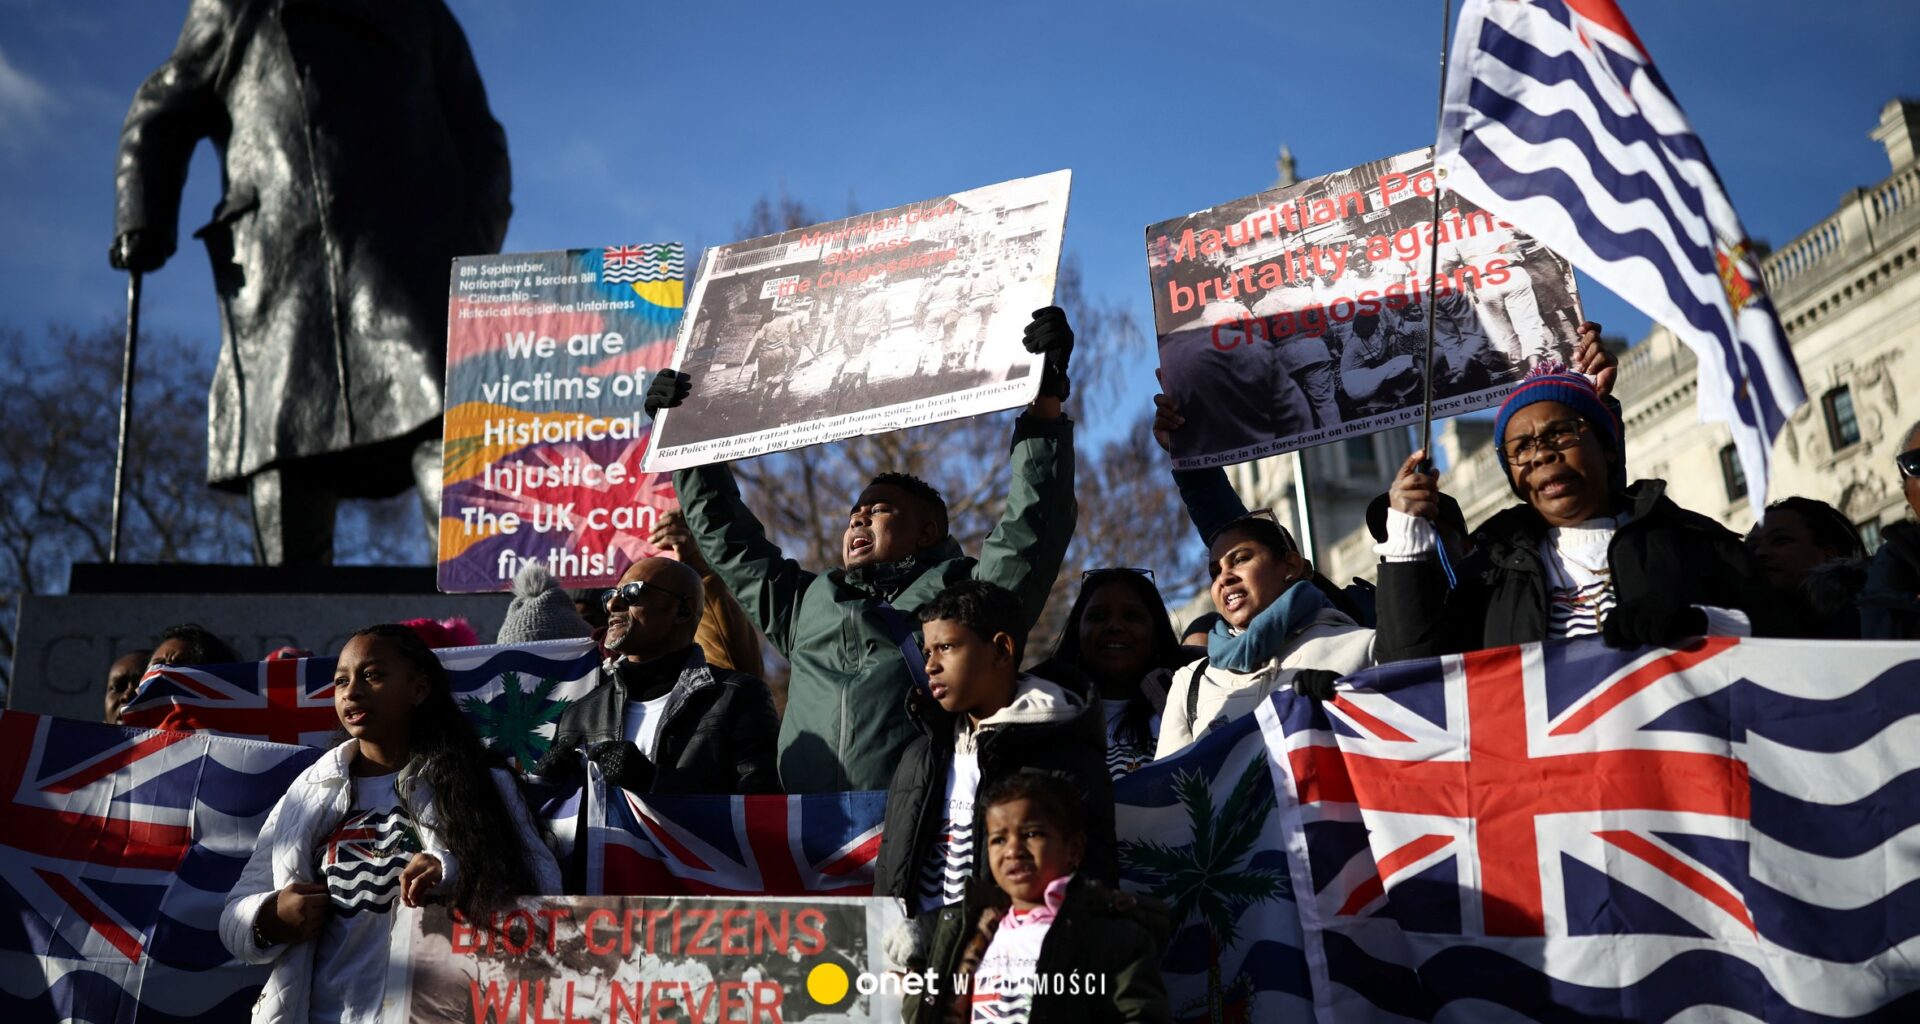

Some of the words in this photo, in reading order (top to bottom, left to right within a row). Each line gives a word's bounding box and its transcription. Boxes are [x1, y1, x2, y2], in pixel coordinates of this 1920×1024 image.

[800, 215, 899, 249] Mauritian
[460, 265, 477, 277] 8th
[777, 277, 811, 298] the
[816, 247, 957, 289] Chagossians
[1168, 244, 1348, 314] brutality
[1366, 207, 1513, 262] again
[460, 277, 520, 291] Nationality
[524, 277, 531, 287] &
[536, 275, 577, 286] Borders
[581, 271, 597, 283] Bill
[468, 290, 529, 304] Citizenship
[459, 306, 511, 319] Historical
[513, 302, 574, 318] Legislative
[576, 299, 635, 313] Unfairness
[1211, 258, 1511, 354] Chagossians
[505, 331, 557, 359] We
[567, 331, 624, 357] are
[482, 373, 601, 404] victims
[612, 367, 646, 397] of
[484, 411, 640, 446] Historical
[658, 448, 678, 459] Riot
[681, 444, 708, 456] Police
[711, 438, 732, 449] with
[734, 434, 757, 445] their
[759, 428, 789, 441] rattan
[792, 419, 826, 434] shields
[828, 416, 846, 428] and
[849, 411, 882, 424] batons
[884, 405, 912, 418] going
[915, 402, 925, 410] to
[928, 394, 956, 407] break
[960, 392, 973, 402] up
[976, 381, 1026, 398] protesters
[713, 449, 746, 461] during
[748, 445, 763, 455] the
[766, 440, 788, 451] 1981
[792, 434, 819, 446] street
[904, 413, 927, 424] Port
[930, 408, 960, 419] Louis.
[1178, 457, 1201, 468] Riot
[1204, 452, 1235, 465] Police
[1238, 449, 1249, 459] in
[1252, 444, 1269, 456] the
[1272, 431, 1325, 451] fore-front
[1328, 427, 1342, 438] on
[1345, 418, 1372, 432] their
[1374, 413, 1397, 427] way
[1399, 411, 1411, 421] to
[1414, 400, 1461, 417] diperse
[1463, 394, 1482, 407] the
[1485, 385, 1514, 402] prot
[484, 457, 636, 496] Injustice.
[461, 507, 520, 535] The
[533, 502, 575, 533] UK
[587, 502, 656, 530] can
[548, 545, 616, 577] this!
[452, 908, 570, 955] BIOT
[585, 908, 827, 955] CITIZENS
[470, 980, 590, 1024] WILL
[610, 980, 784, 1024] NEVER
